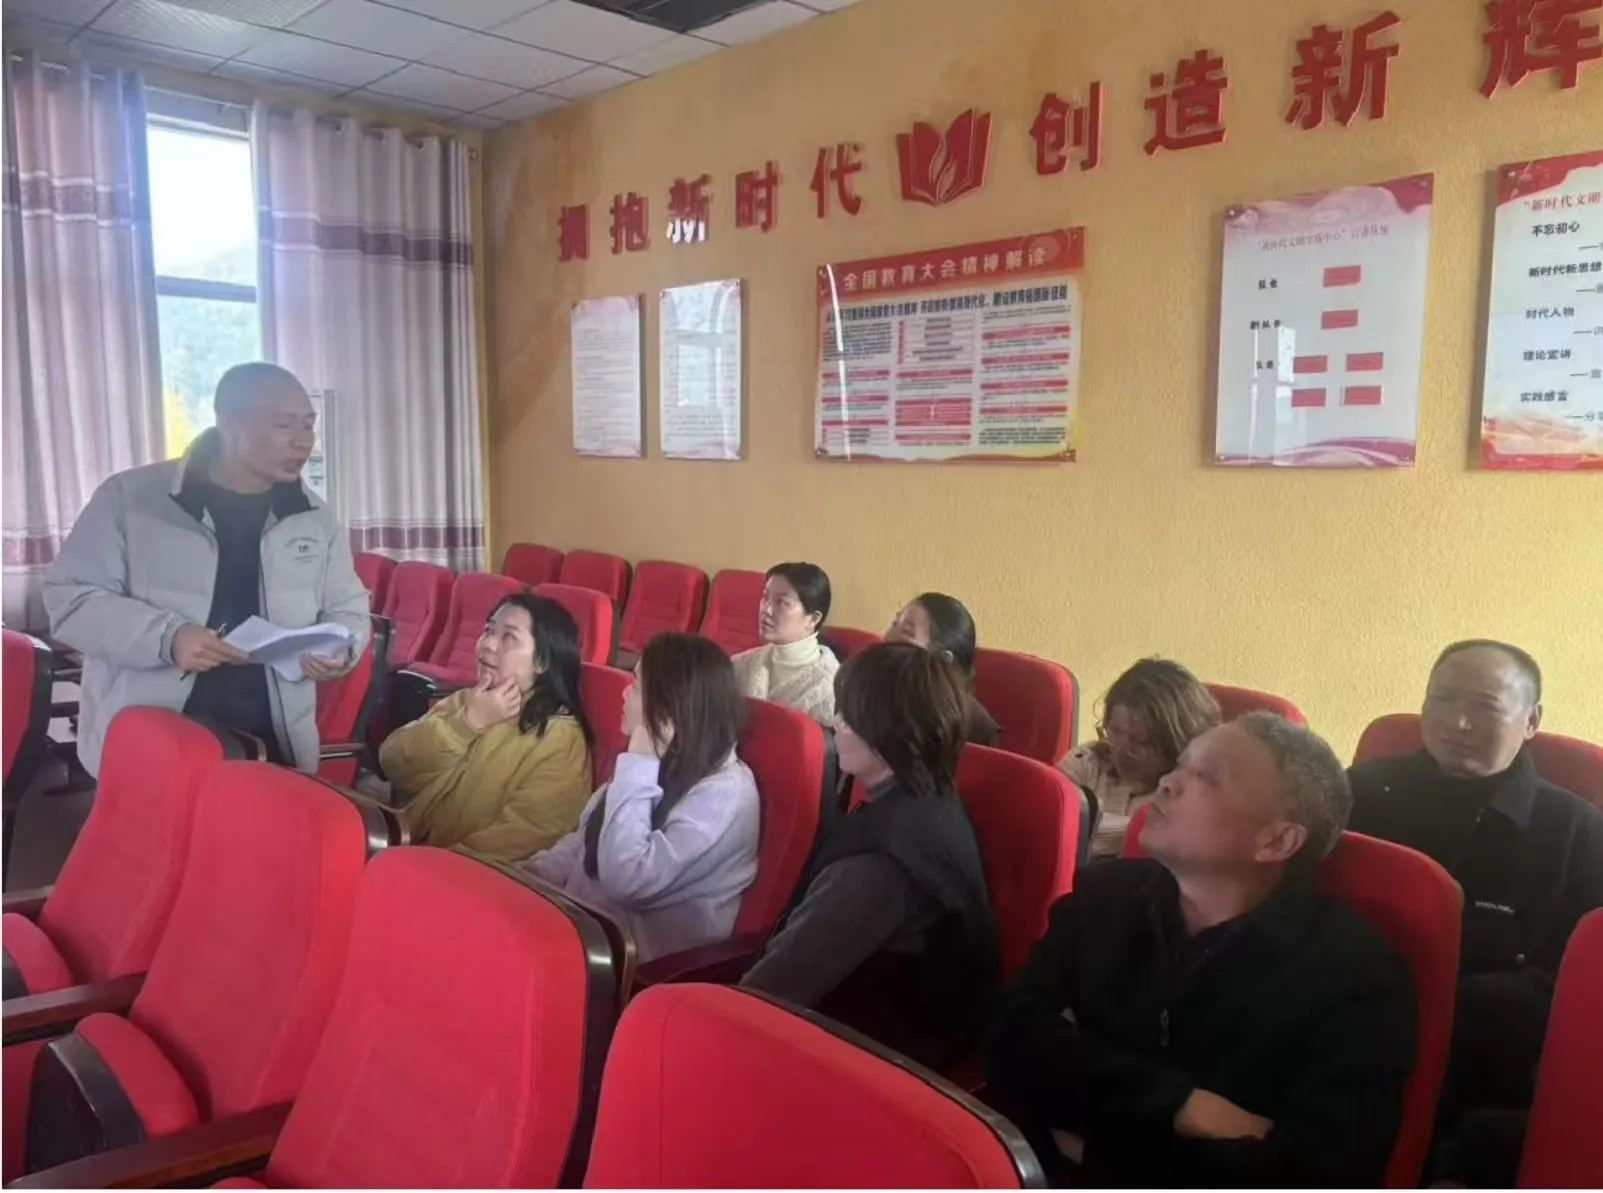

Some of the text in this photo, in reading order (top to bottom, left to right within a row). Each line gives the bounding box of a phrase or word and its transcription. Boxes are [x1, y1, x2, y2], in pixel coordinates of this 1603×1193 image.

[558, 141, 866, 263] 拥抱新时代
[1531, 221, 1581, 237] 不忘初心
[842, 247, 1047, 292] 全国教育大会精神解读
[1528, 261, 1602, 278] 新时代新思想
[1525, 307, 1575, 319] 时代人物
[1523, 349, 1571, 361] 理论宣讲
[1520, 390, 1568, 402] 实践感言
